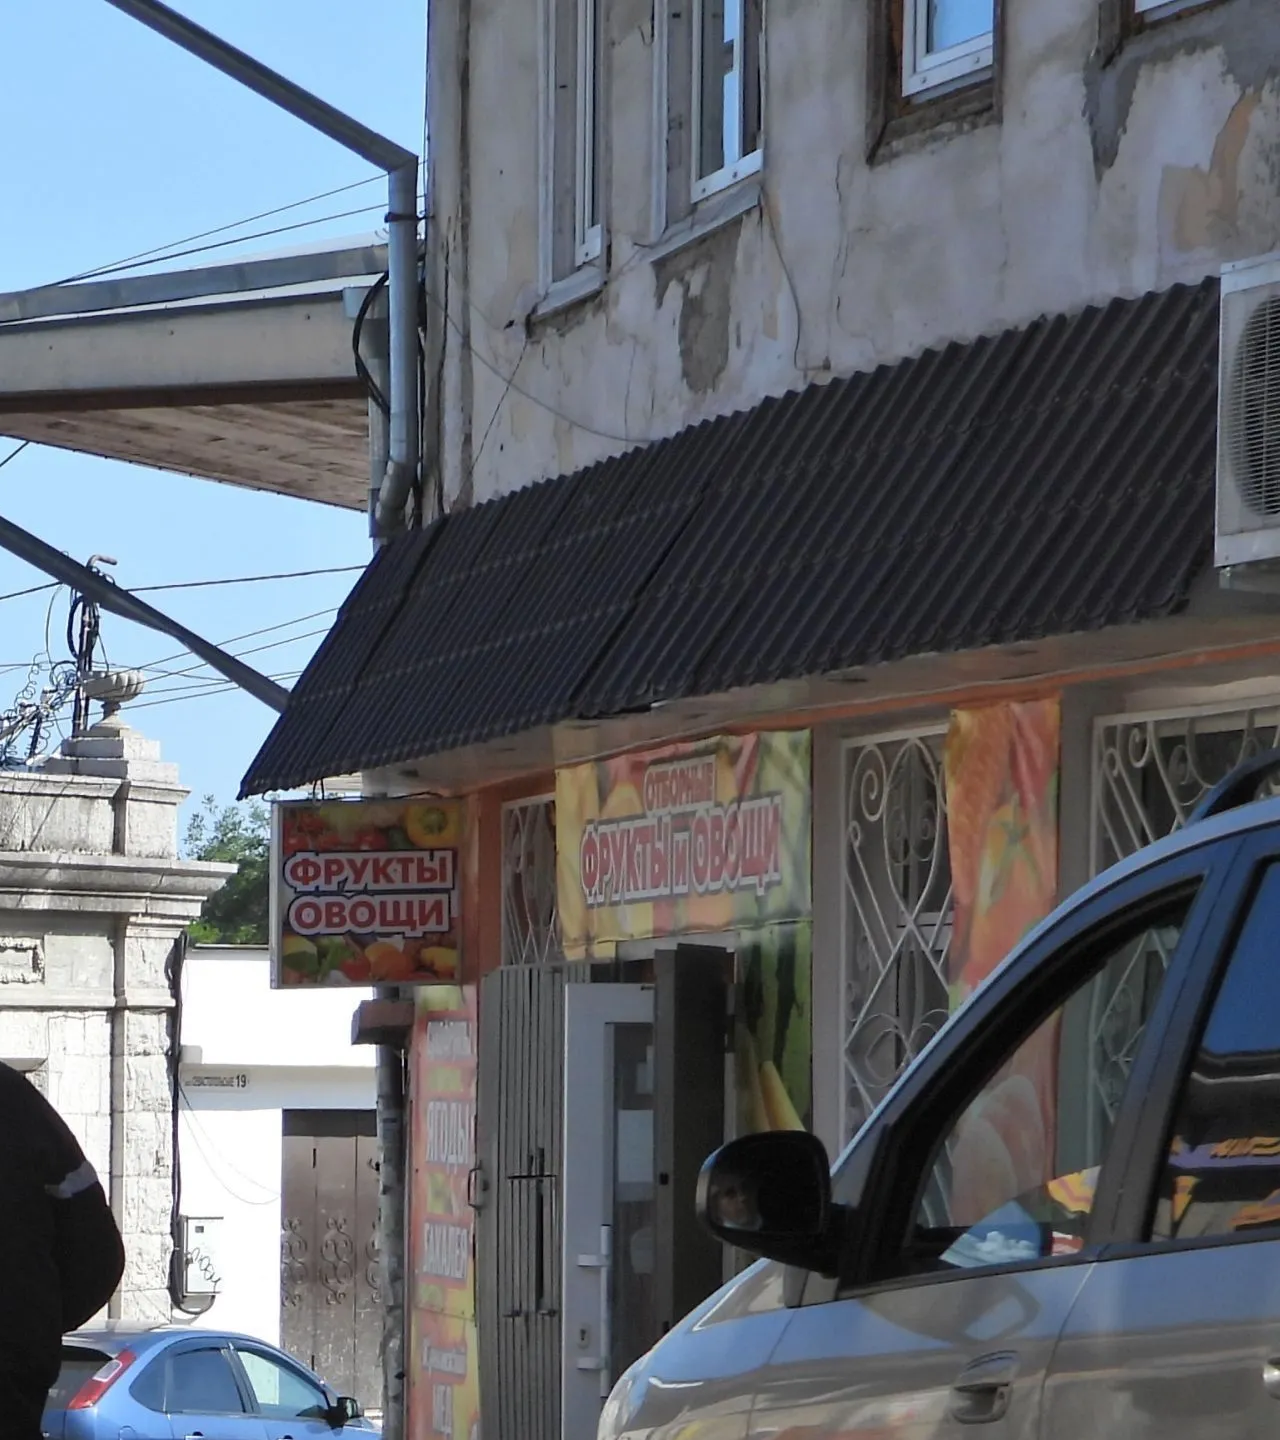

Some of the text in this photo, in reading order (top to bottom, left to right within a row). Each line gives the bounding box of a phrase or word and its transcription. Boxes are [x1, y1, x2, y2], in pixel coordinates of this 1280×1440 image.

[645, 761, 713, 811] ОТБОРНЫЕ
[582, 816, 670, 896] ФРУКТЫ
[693, 802, 780, 889] ОВОЩИ
[289, 856, 448, 886] ФРУКТЫ
[294, 899, 444, 931] ОВОЩИ
[236, 1074, 247, 1088] 19
[425, 1100, 469, 1174] ЯГОДЫ
